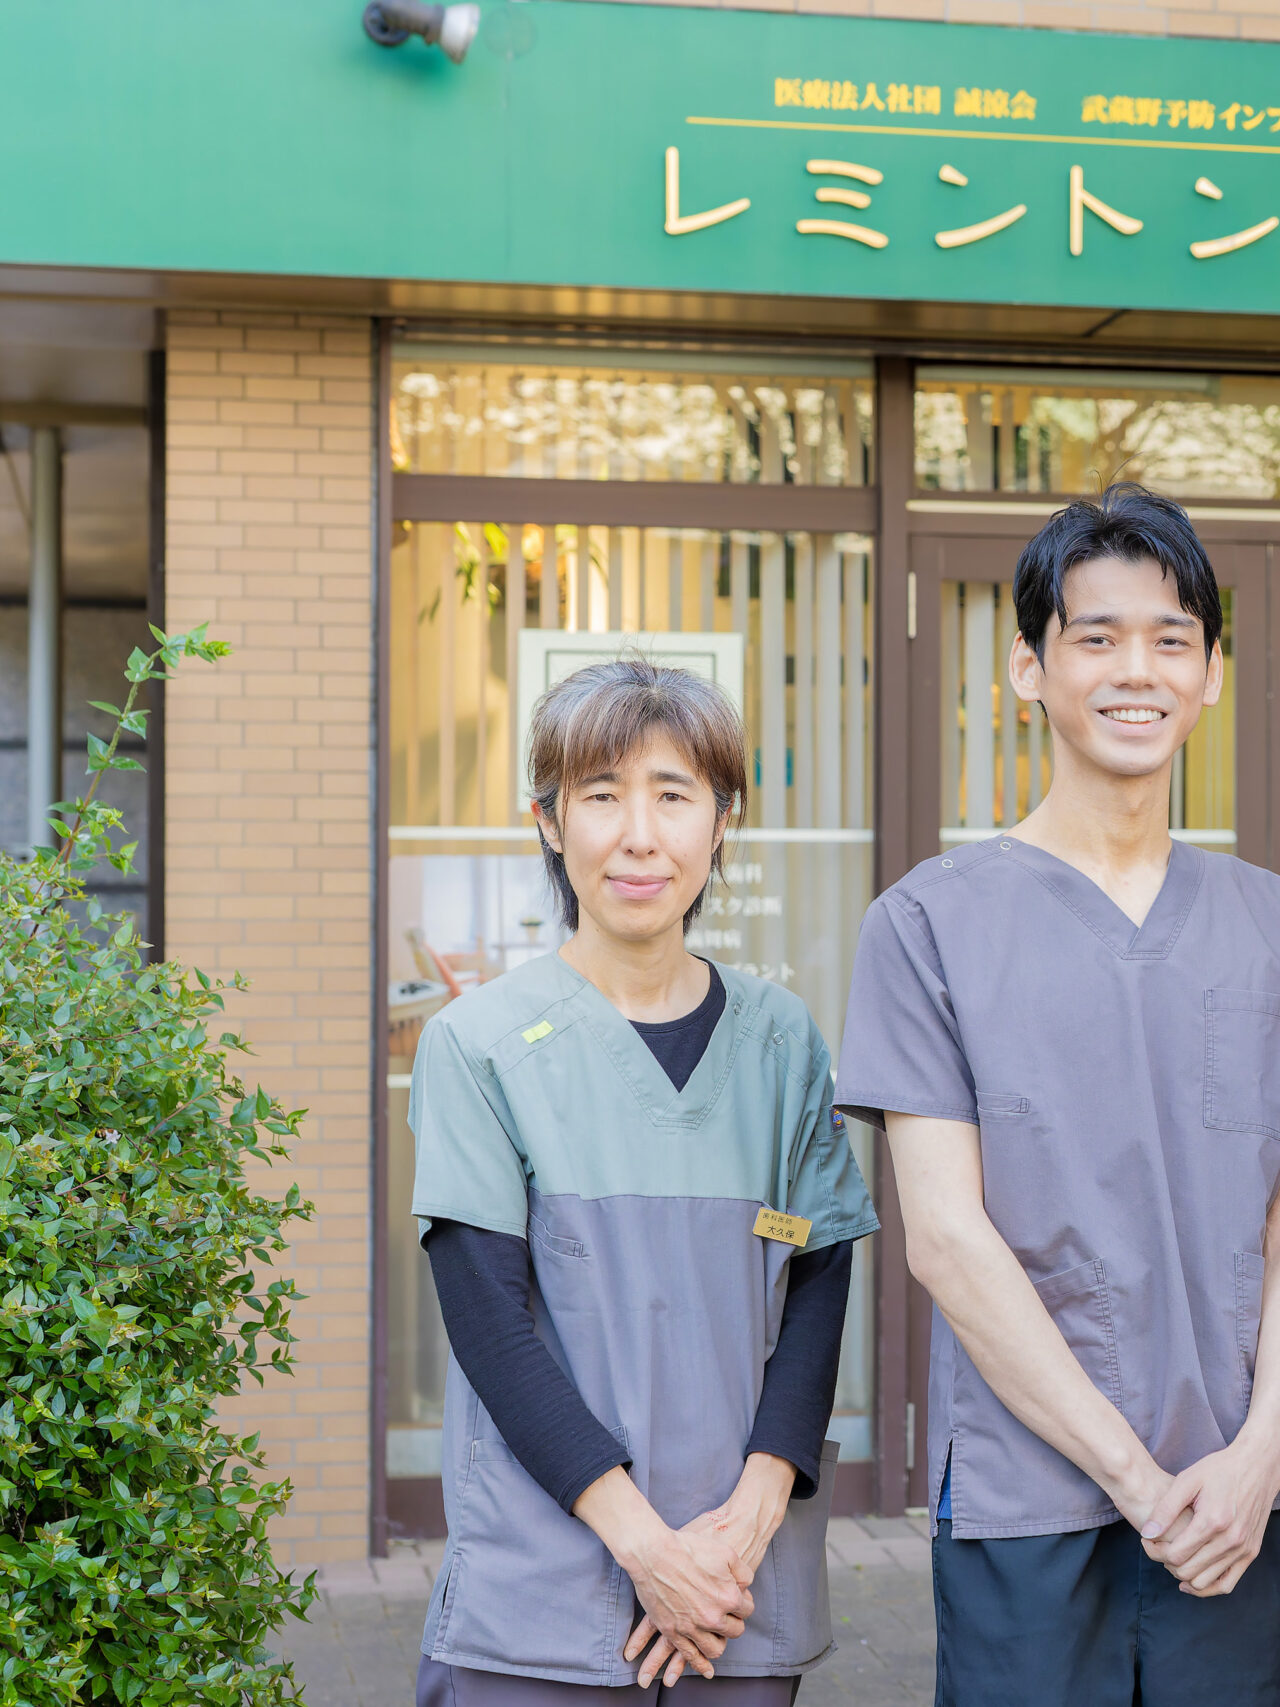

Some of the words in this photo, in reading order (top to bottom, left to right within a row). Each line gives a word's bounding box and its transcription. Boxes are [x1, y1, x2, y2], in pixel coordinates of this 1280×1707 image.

[775, 77, 941, 115] 医療法人社団
[766, 1225, 795, 1239] 大久保
